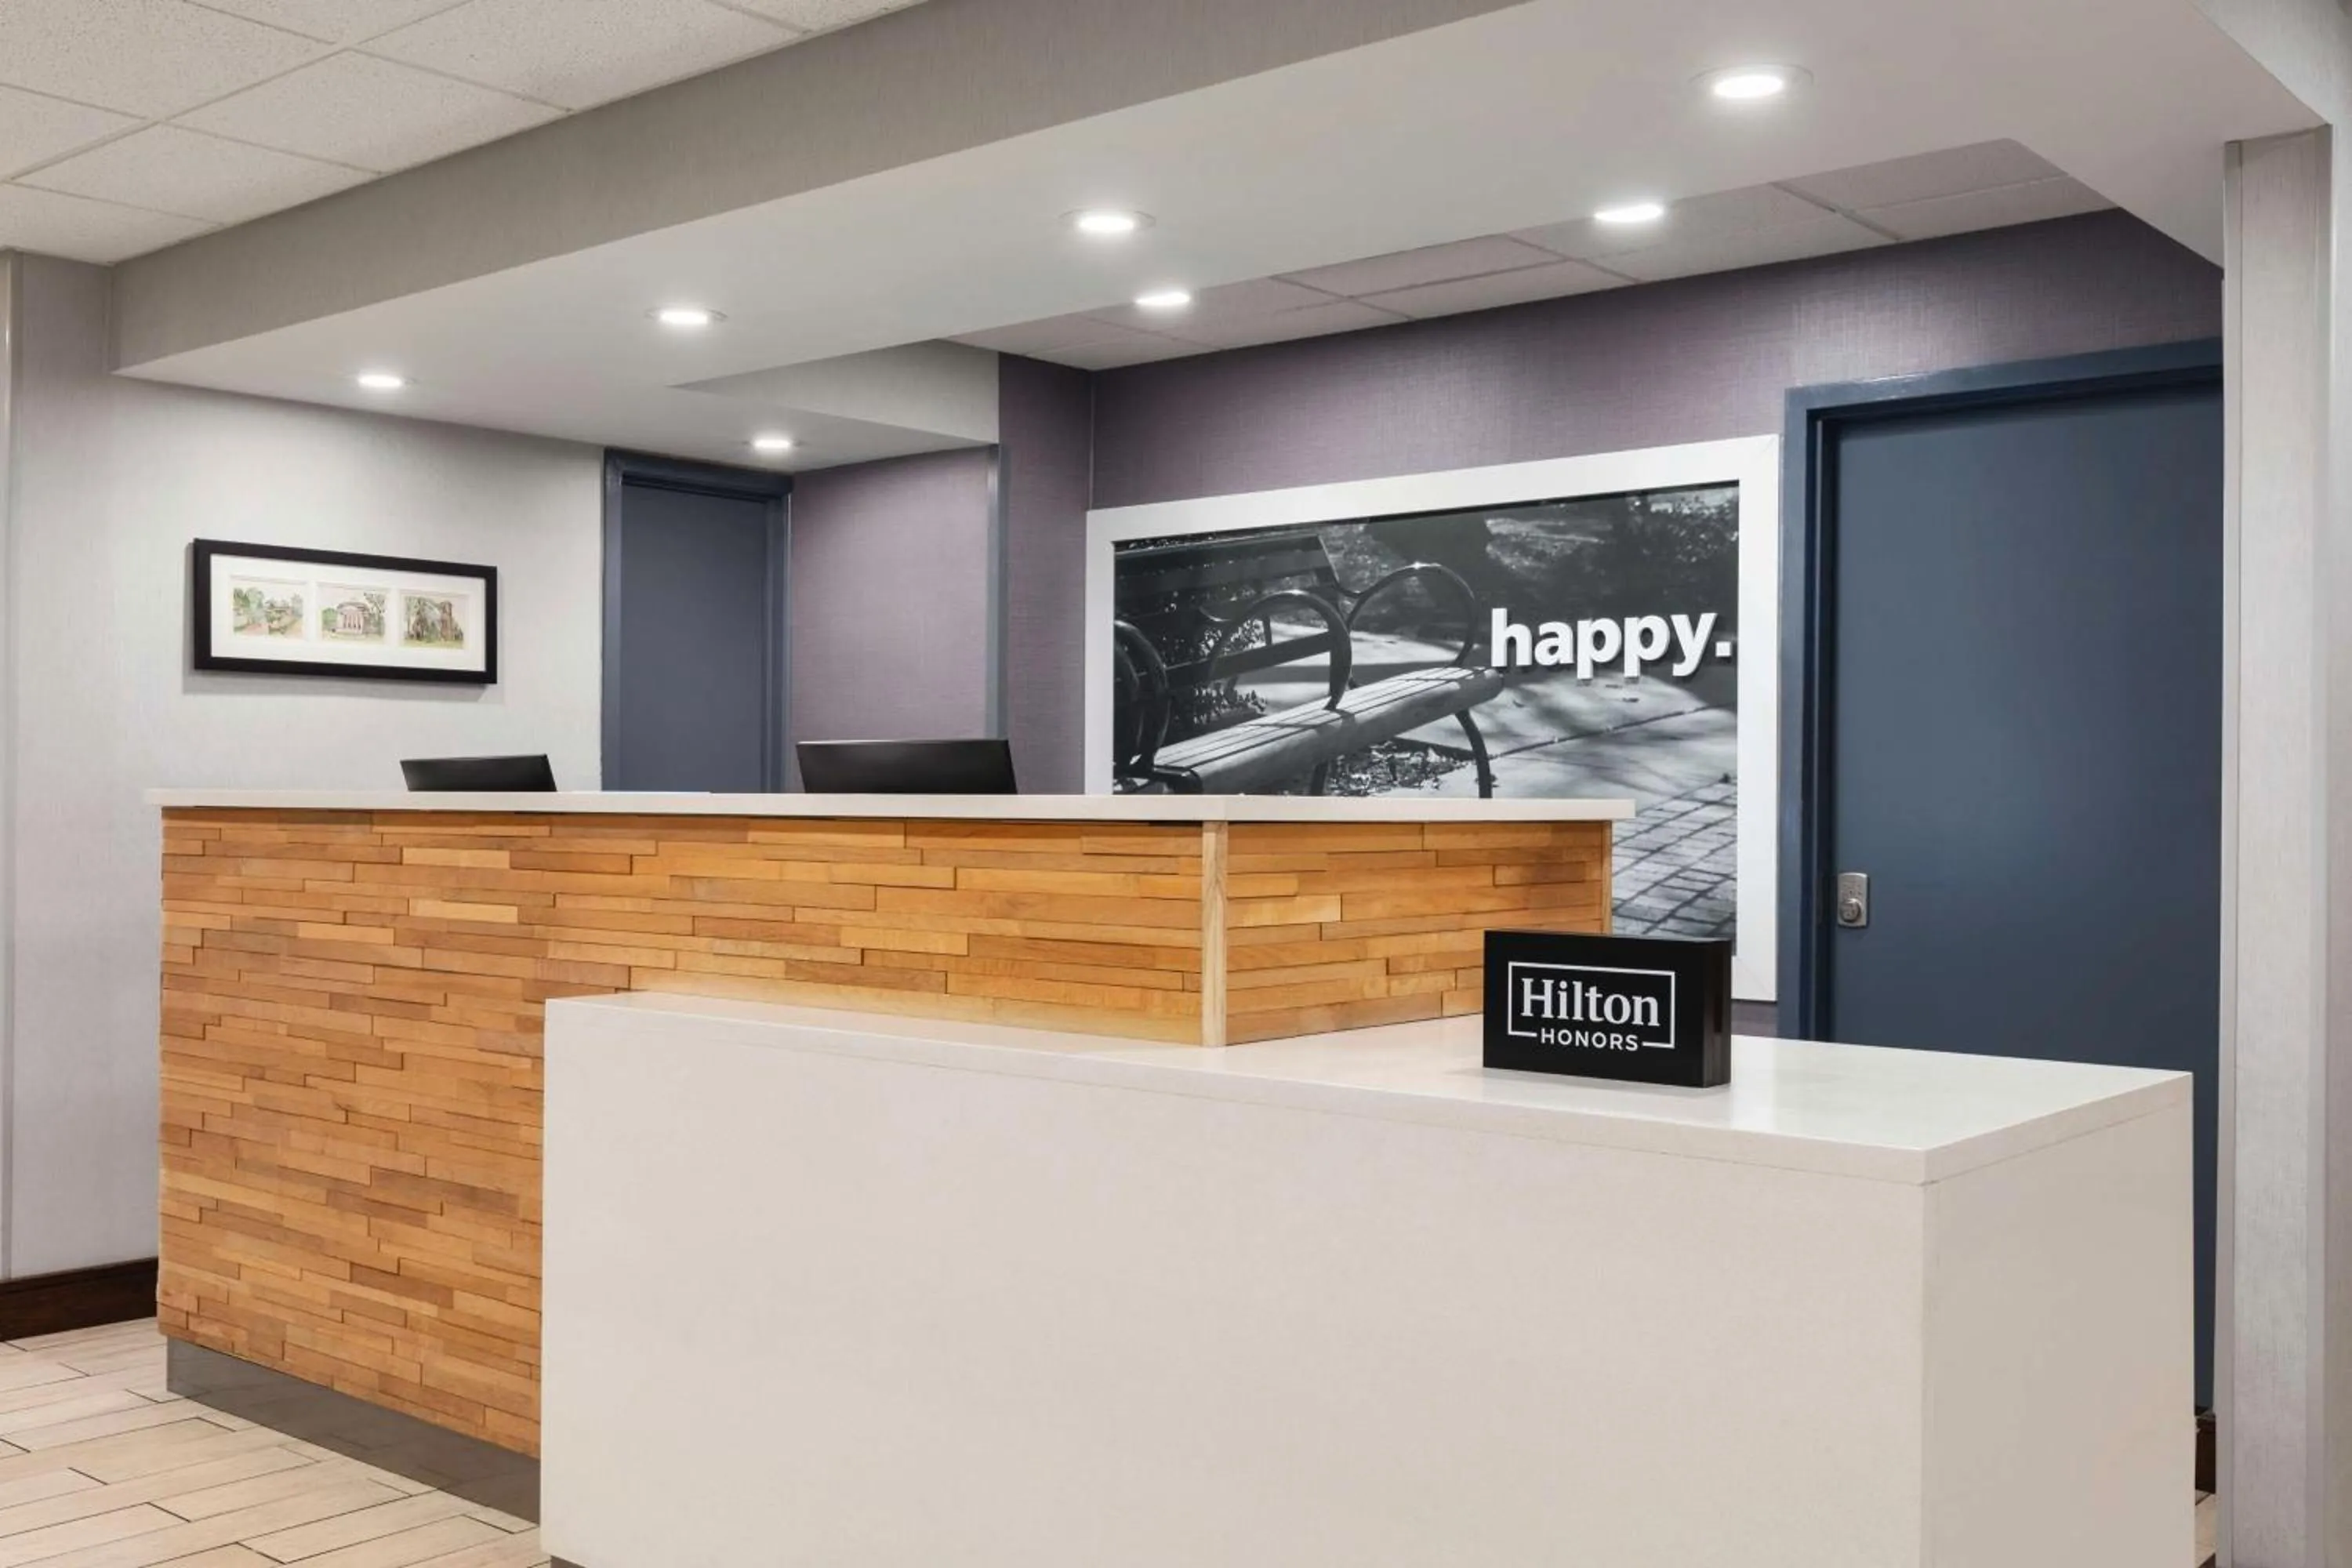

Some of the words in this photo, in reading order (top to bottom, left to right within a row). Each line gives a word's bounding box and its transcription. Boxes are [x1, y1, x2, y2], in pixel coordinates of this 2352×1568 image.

[1490, 608, 1732, 680] happy.
[1520, 978, 1660, 1027] Hilton
[1541, 1027, 1639, 1051] HONORS
